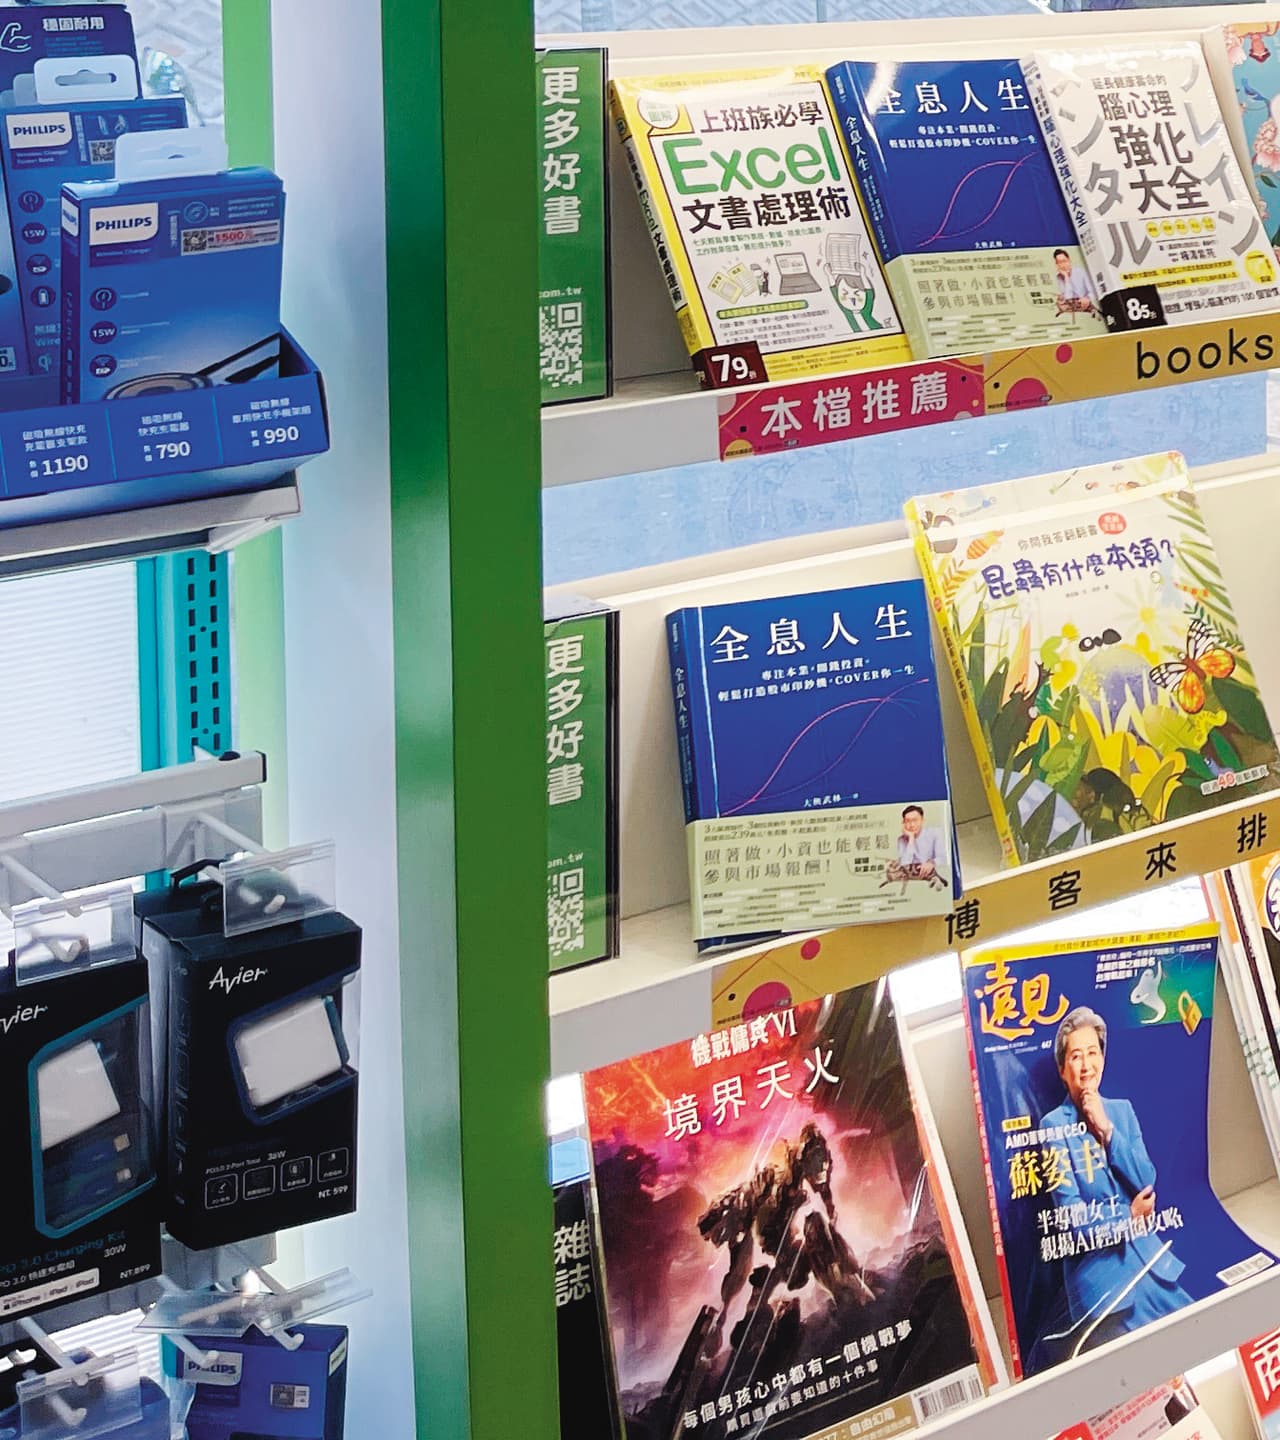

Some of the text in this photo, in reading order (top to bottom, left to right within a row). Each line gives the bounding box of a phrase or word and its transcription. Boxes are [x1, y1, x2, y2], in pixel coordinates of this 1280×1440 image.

[876, 78, 1029, 115] 全息人生
[1098, 90, 1177, 121] 腦心理
[13, 123, 66, 137] PHILIPS
[701, 100, 824, 134] 上班族必學
[542, 66, 581, 236] 更多好書
[662, 126, 841, 195] Excel
[1109, 122, 1193, 168] 強化
[1130, 166, 1209, 214] 大全
[95, 215, 152, 232] PHILIPS
[682, 186, 851, 235] 文書處理術
[23, 228, 45, 239] 15W
[92, 327, 116, 338] 15W
[760, 371, 949, 439] 本檔推薦
[155, 441, 191, 460] 790
[264, 426, 299, 444] 990
[42, 455, 89, 477] 1190
[710, 604, 912, 664] 全息人生
[546, 634, 585, 807] 更多好書
[209, 966, 267, 996] Avier
[975, 955, 1069, 1041] 遠見
[0, 1005, 46, 1034] vier
[663, 1044, 840, 1142] 境界天火
[1008, 1140, 1105, 1200] 蘇姿丰
[1037, 1195, 1123, 1236] 半導體女王
[104, 1245, 126, 1258] 30W
[554, 1221, 591, 1307] 雜誌
[188, 1360, 236, 1375] PLIPS
[682, 1317, 913, 1431] 每個男孩心中都有一個機戰夢
